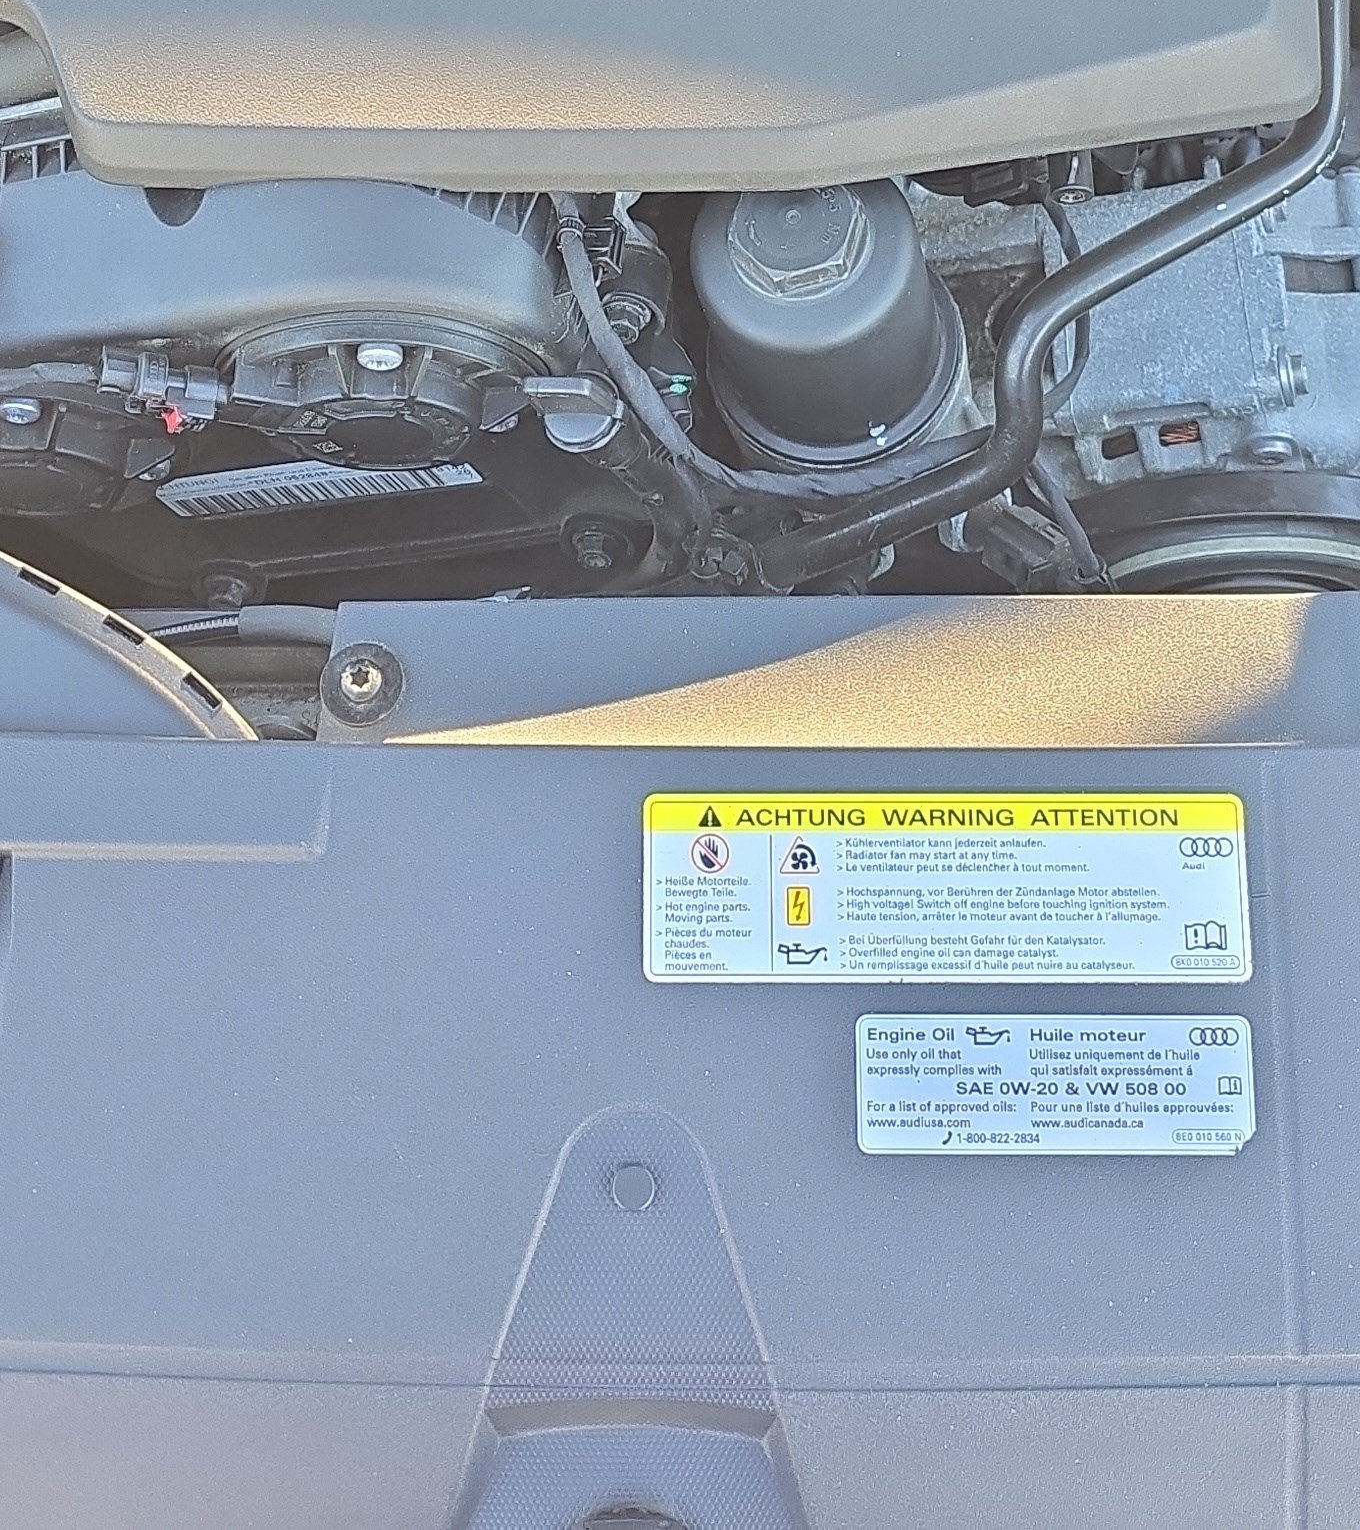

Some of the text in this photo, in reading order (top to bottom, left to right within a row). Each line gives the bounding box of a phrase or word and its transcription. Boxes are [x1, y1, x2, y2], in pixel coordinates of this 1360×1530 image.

[736, 809, 1177, 826] ACHTUNG WARNING ATTENTION
[845, 837, 1047, 850] Kühlerventilator kann jederzeit anlaufen.
[845, 849, 1018, 862] Radiator fan may start at any time.
[845, 862, 1090, 874] Le ventilateur peut se déclencher à tout moment.
[1181, 861, 1206, 870] Audi
[665, 875, 752, 887] Heiße Motorteile.
[665, 887, 737, 900] Bewegte Teile.
[846, 886, 1160, 899] Hochspannung, vor Berühren der Zündanlage Motor abstellen.
[665, 901, 751, 914] Hot engine parts.
[846, 898, 871, 911] High
[916, 898, 951, 909] Switch
[953, 898, 968, 909] off
[970, 898, 1005, 911] engine
[1006, 898, 1040, 909] before
[1042, 898, 1087, 911] touching
[1089, 898, 1129, 911] ignition
[1130, 900, 1170, 911] system.
[664, 912, 733, 925] Moving parts.
[846, 910, 877, 922] Haute
[879, 911, 920, 922] tension,
[921, 911, 956, 922] arrêter
[958, 911, 968, 921] le
[969, 912, 1007, 922] moteur
[1009, 912, 1038, 922] avant
[1039, 911, 1053, 921] de
[1054, 911, 1094, 922] toucher
[1096, 911, 1103, 921] à
[665, 927, 752, 938] Pièces du moteur
[664, 938, 710, 949] chaudes.
[848, 932, 1106, 948] Bei Überfüllung besteht Gefahr für den Katalysator.
[664, 949, 712, 960] Pièces en
[848, 947, 1059, 960] Overfilled engine oil can damage catalyst.
[664, 962, 729, 971] mouvement.
[849, 959, 865, 970] Un
[866, 959, 929, 972] remplissage
[930, 959, 972, 970] excessif
[1011, 961, 1035, 971] peut
[1036, 959, 1063, 970] nuire
[1065, 961, 1079, 970] au
[1080, 960, 1135, 972] catalyseur.
[1193, 957, 1210, 967] 010
[1229, 957, 1237, 967] A
[868, 1028, 954, 1043] Engine Oil
[1031, 1029, 1146, 1041] Huile moteur
[866, 1047, 962, 1062] Use only oil that
[1029, 1048, 1072, 1060] Utilisez
[1074, 1048, 1145, 1063] uniquement
[1147, 1048, 1162, 1061] de
[866, 1063, 1002, 1078] expressly complies with
[1030, 1063, 1049, 1078] qui
[1051, 1063, 1098, 1076] satisfait
[1100, 1064, 1184, 1079] expressément
[957, 1082, 1186, 1095] SAE 0W-20 & VW 508 00
[867, 1100, 1017, 1115] For a list of approved oils:
[1030, 1100, 1058, 1113] Pour
[1061, 1103, 1083, 1113] une
[1086, 1100, 1111, 1113] liste
[1162, 1101, 1234, 1116] approuvées:
[866, 1116, 971, 1129] www.audiusa.com
[1030, 1117, 1144, 1129] www.audicanada.ca
[956, 1132, 1040, 1144] 1-800-822-2834
[1195, 1132, 1213, 1142] 010
[1234, 1132, 1243, 1142] N
